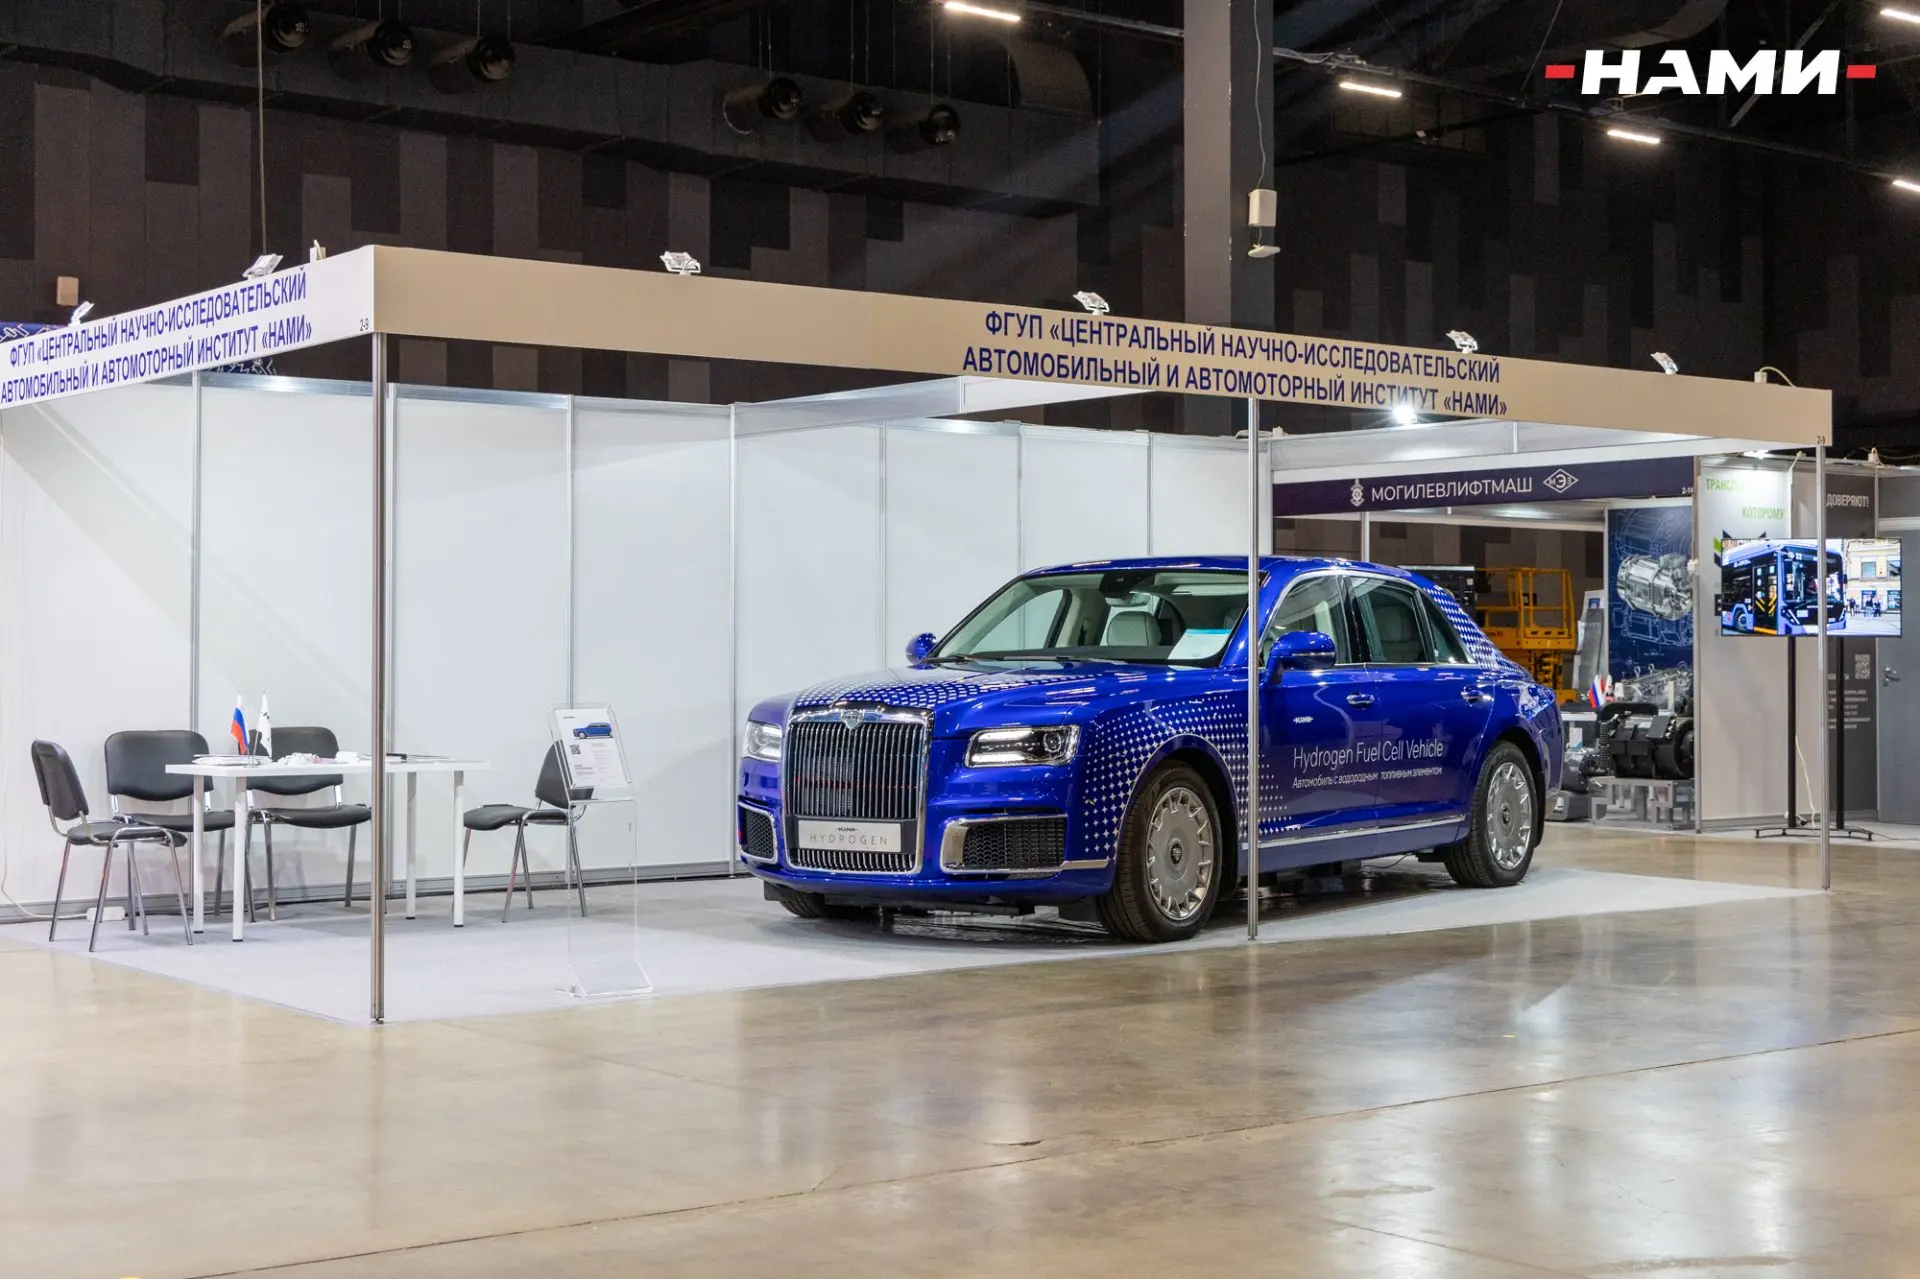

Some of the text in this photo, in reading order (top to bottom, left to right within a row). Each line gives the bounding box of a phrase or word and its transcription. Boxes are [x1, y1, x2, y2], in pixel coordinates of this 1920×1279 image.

[10, 267, 306, 368] ФГУП «ЦЕНТРАЛЬНЫЙ НАУЧНО-ИССЛЕДОВАТЕЛЬСКИЙ
[1, 315, 312, 404] АВТОМОБИЛЬНЫЙ И АВТОМОТОРНЫЙ ИНСТИТУТ «НАМИ»
[985, 310, 1500, 383] ФГУП «ЦЕНТРАЛЬНЫЙ НАУЧНО-ИССЛЕДОВАТЕЛЬСКИЙ
[962, 346, 1507, 415] АВТОМОБИЛЬНЫЙ И АВТОМОТОРНЫЙ ИНСТИТУТ «НАМИ»
[1371, 476, 1533, 502] МОГИЛЕВЛИФТМАШ
[1826, 493, 1870, 508] ДОВЕРЯЮТ!
[1741, 506, 1785, 520] КОТОРОМУ
[1293, 738, 1444, 774] Hydrogen Fuel Cell Vehicle
[1292, 774, 1333, 789] Автомобиль
[1338, 771, 1378, 784] водородным
[809, 833, 887, 845] HYDROGEN
